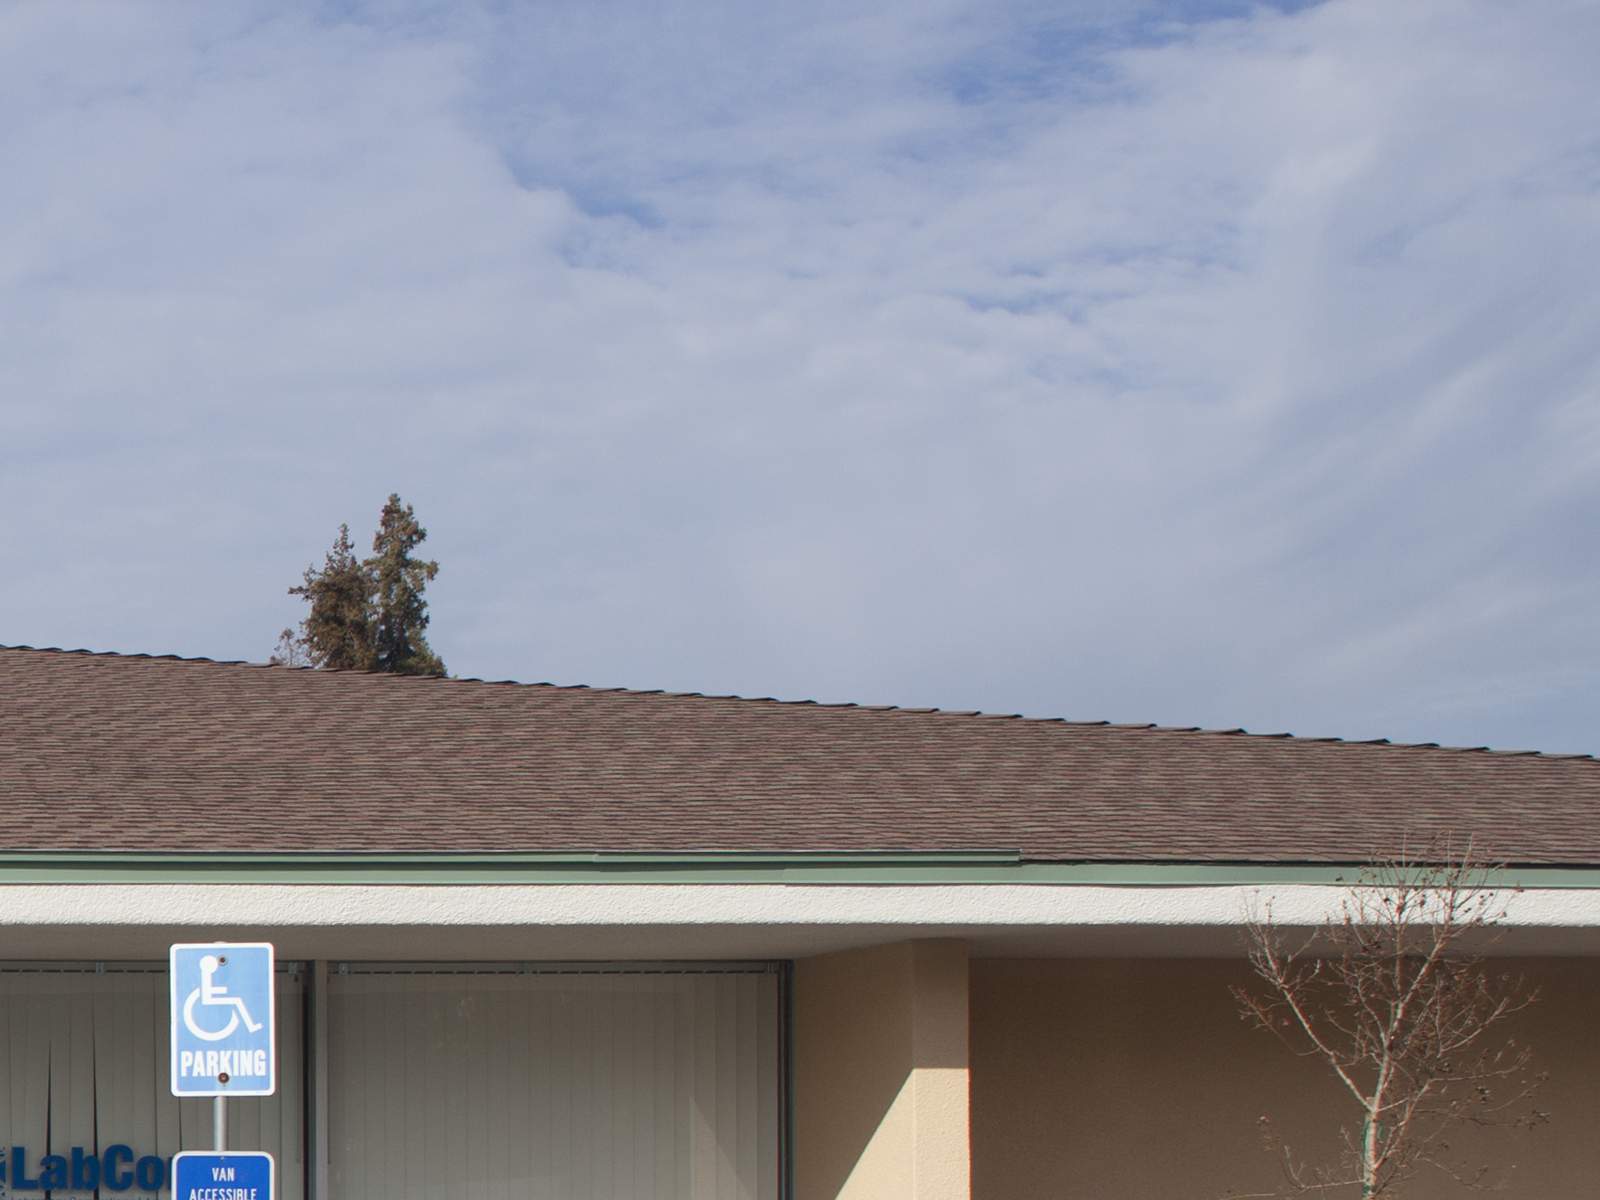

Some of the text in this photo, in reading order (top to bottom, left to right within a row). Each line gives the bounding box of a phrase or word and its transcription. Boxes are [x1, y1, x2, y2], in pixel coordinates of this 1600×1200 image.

[180, 1050, 266, 1077] PARKING
[10, 1144, 172, 1191] LabCo
[212, 1167, 235, 1181] VAN
